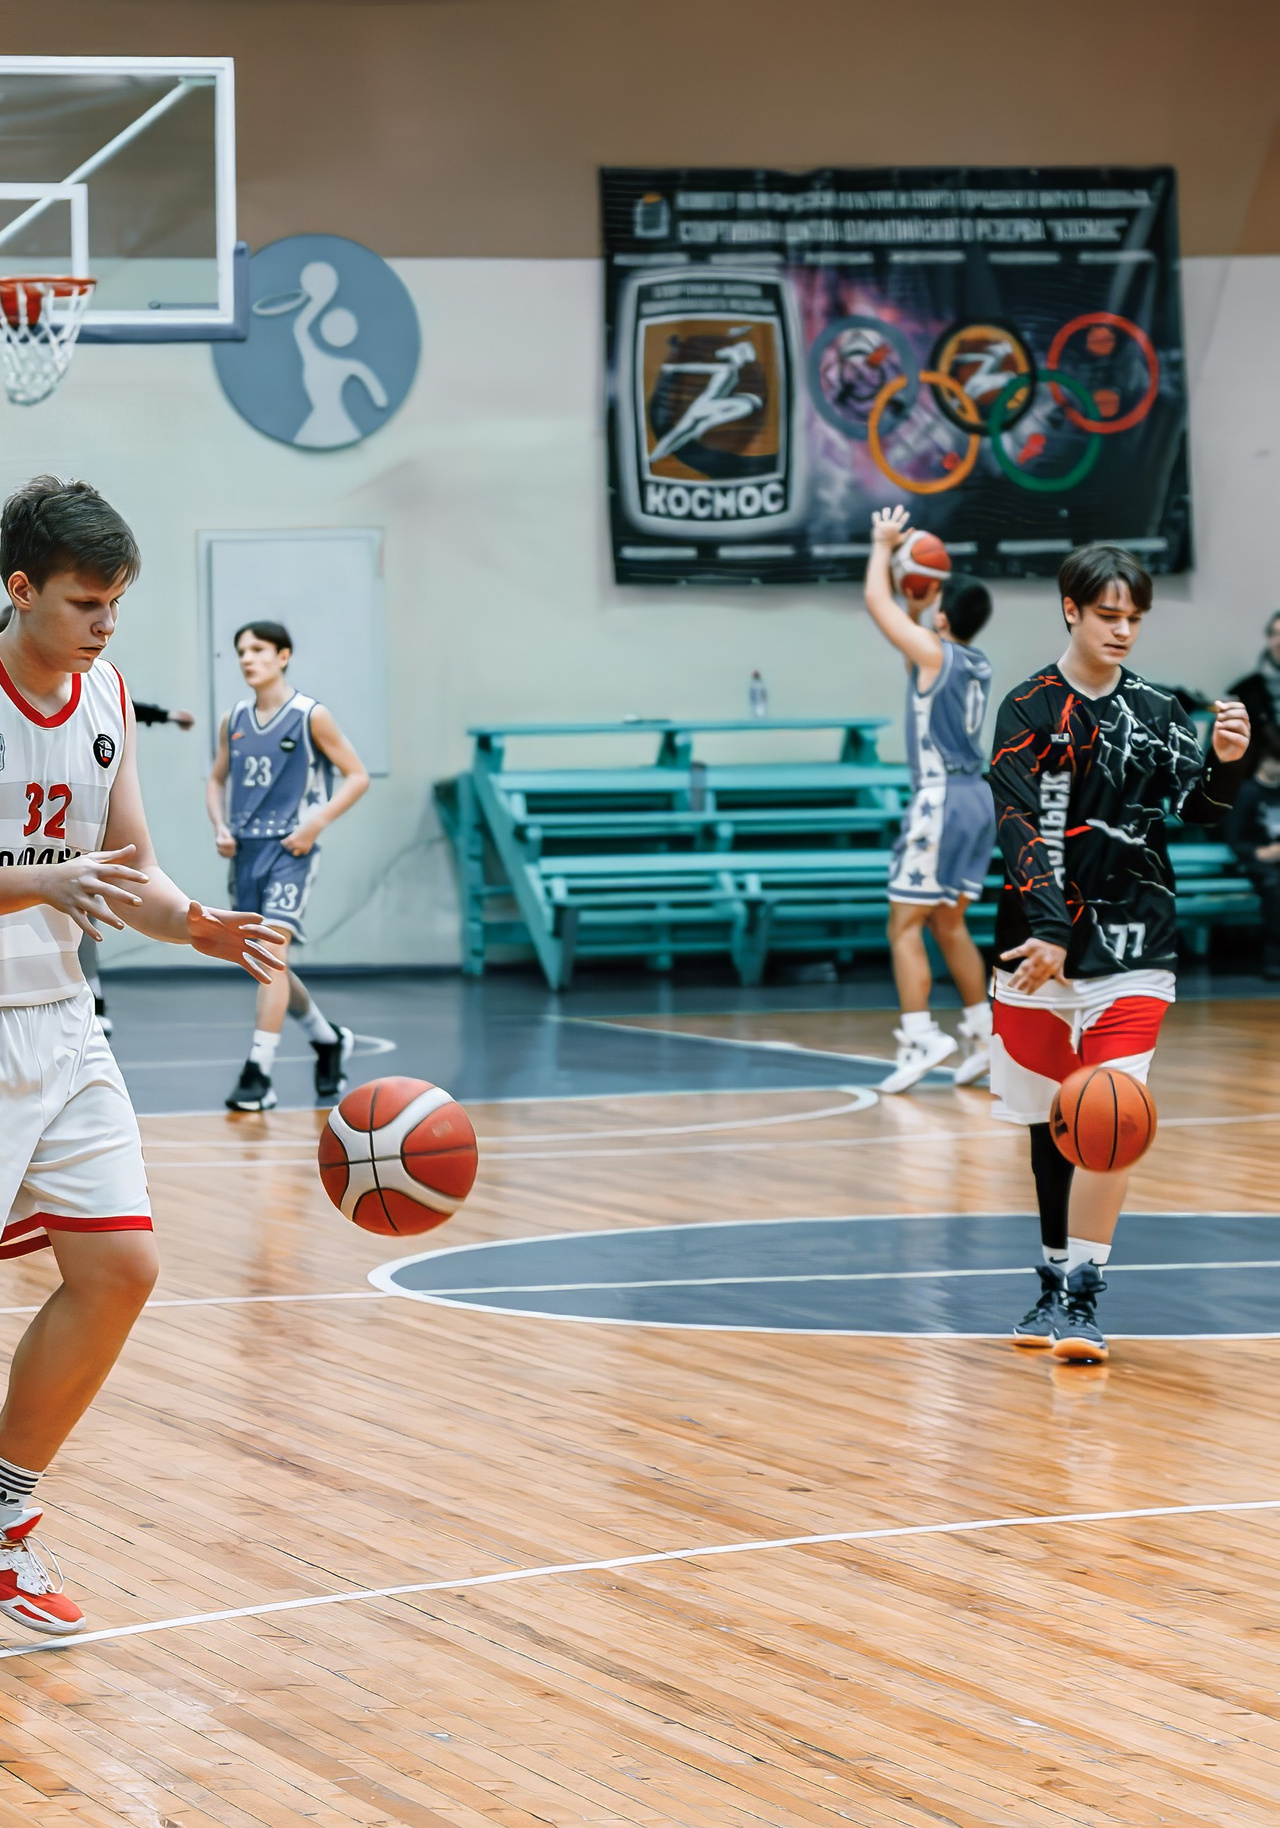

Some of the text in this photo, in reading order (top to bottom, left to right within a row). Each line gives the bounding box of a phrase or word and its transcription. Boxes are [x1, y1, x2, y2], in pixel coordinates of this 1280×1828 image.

[646, 482, 785, 518] КОСМОС
[243, 755, 272, 787] 23
[23, 782, 72, 839] 32
[266, 881, 298, 911] 23
[1108, 922, 1146, 960] 77
